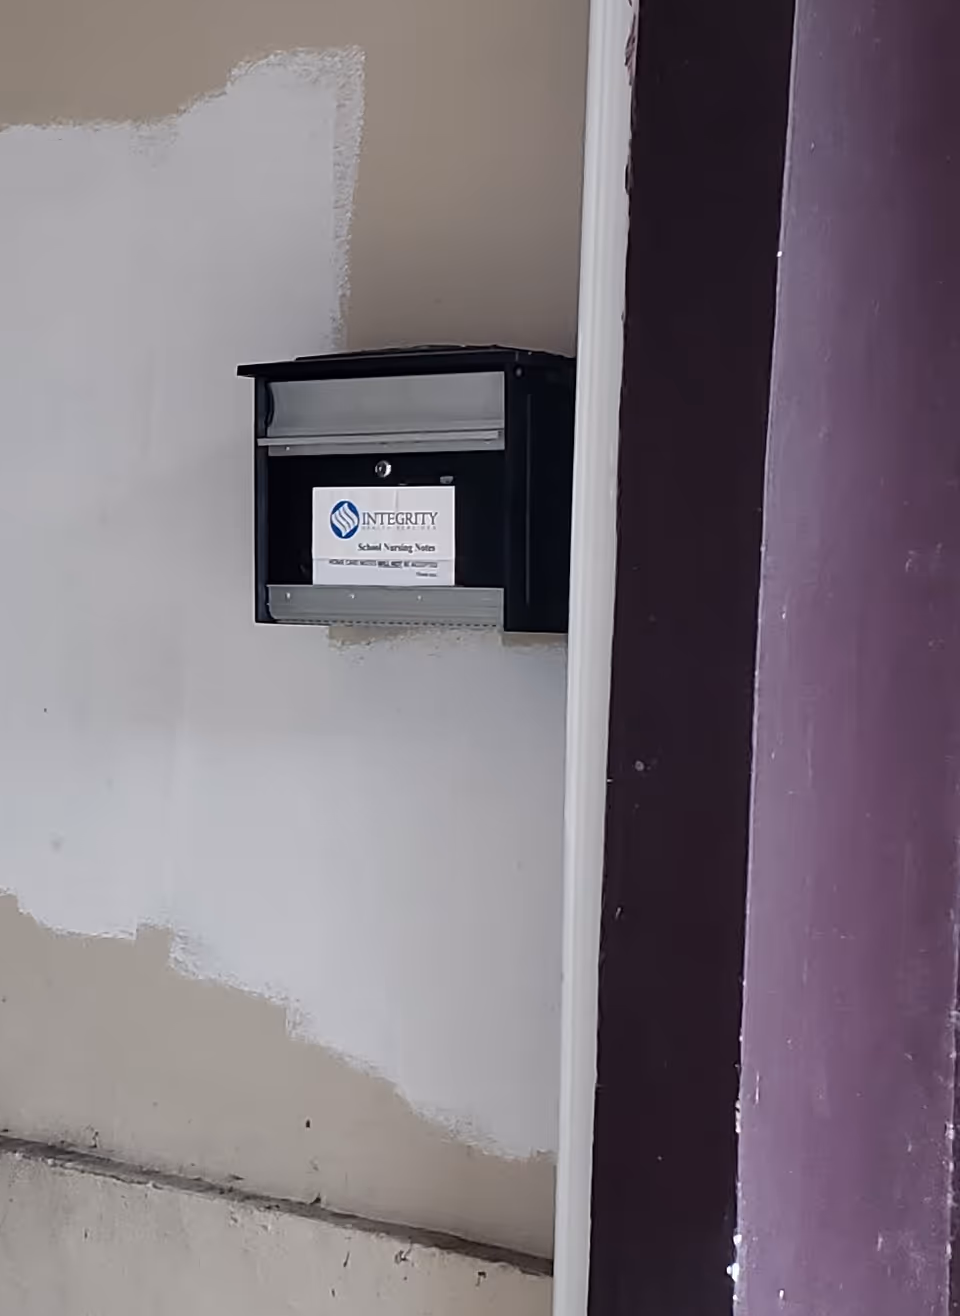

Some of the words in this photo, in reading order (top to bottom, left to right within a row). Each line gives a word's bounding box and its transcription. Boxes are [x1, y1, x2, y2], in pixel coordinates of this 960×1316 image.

[362, 512, 438, 525] INTEGRITY
[358, 543, 381, 551] School
[383, 543, 413, 553] Nursing
[415, 543, 436, 552] Notes
